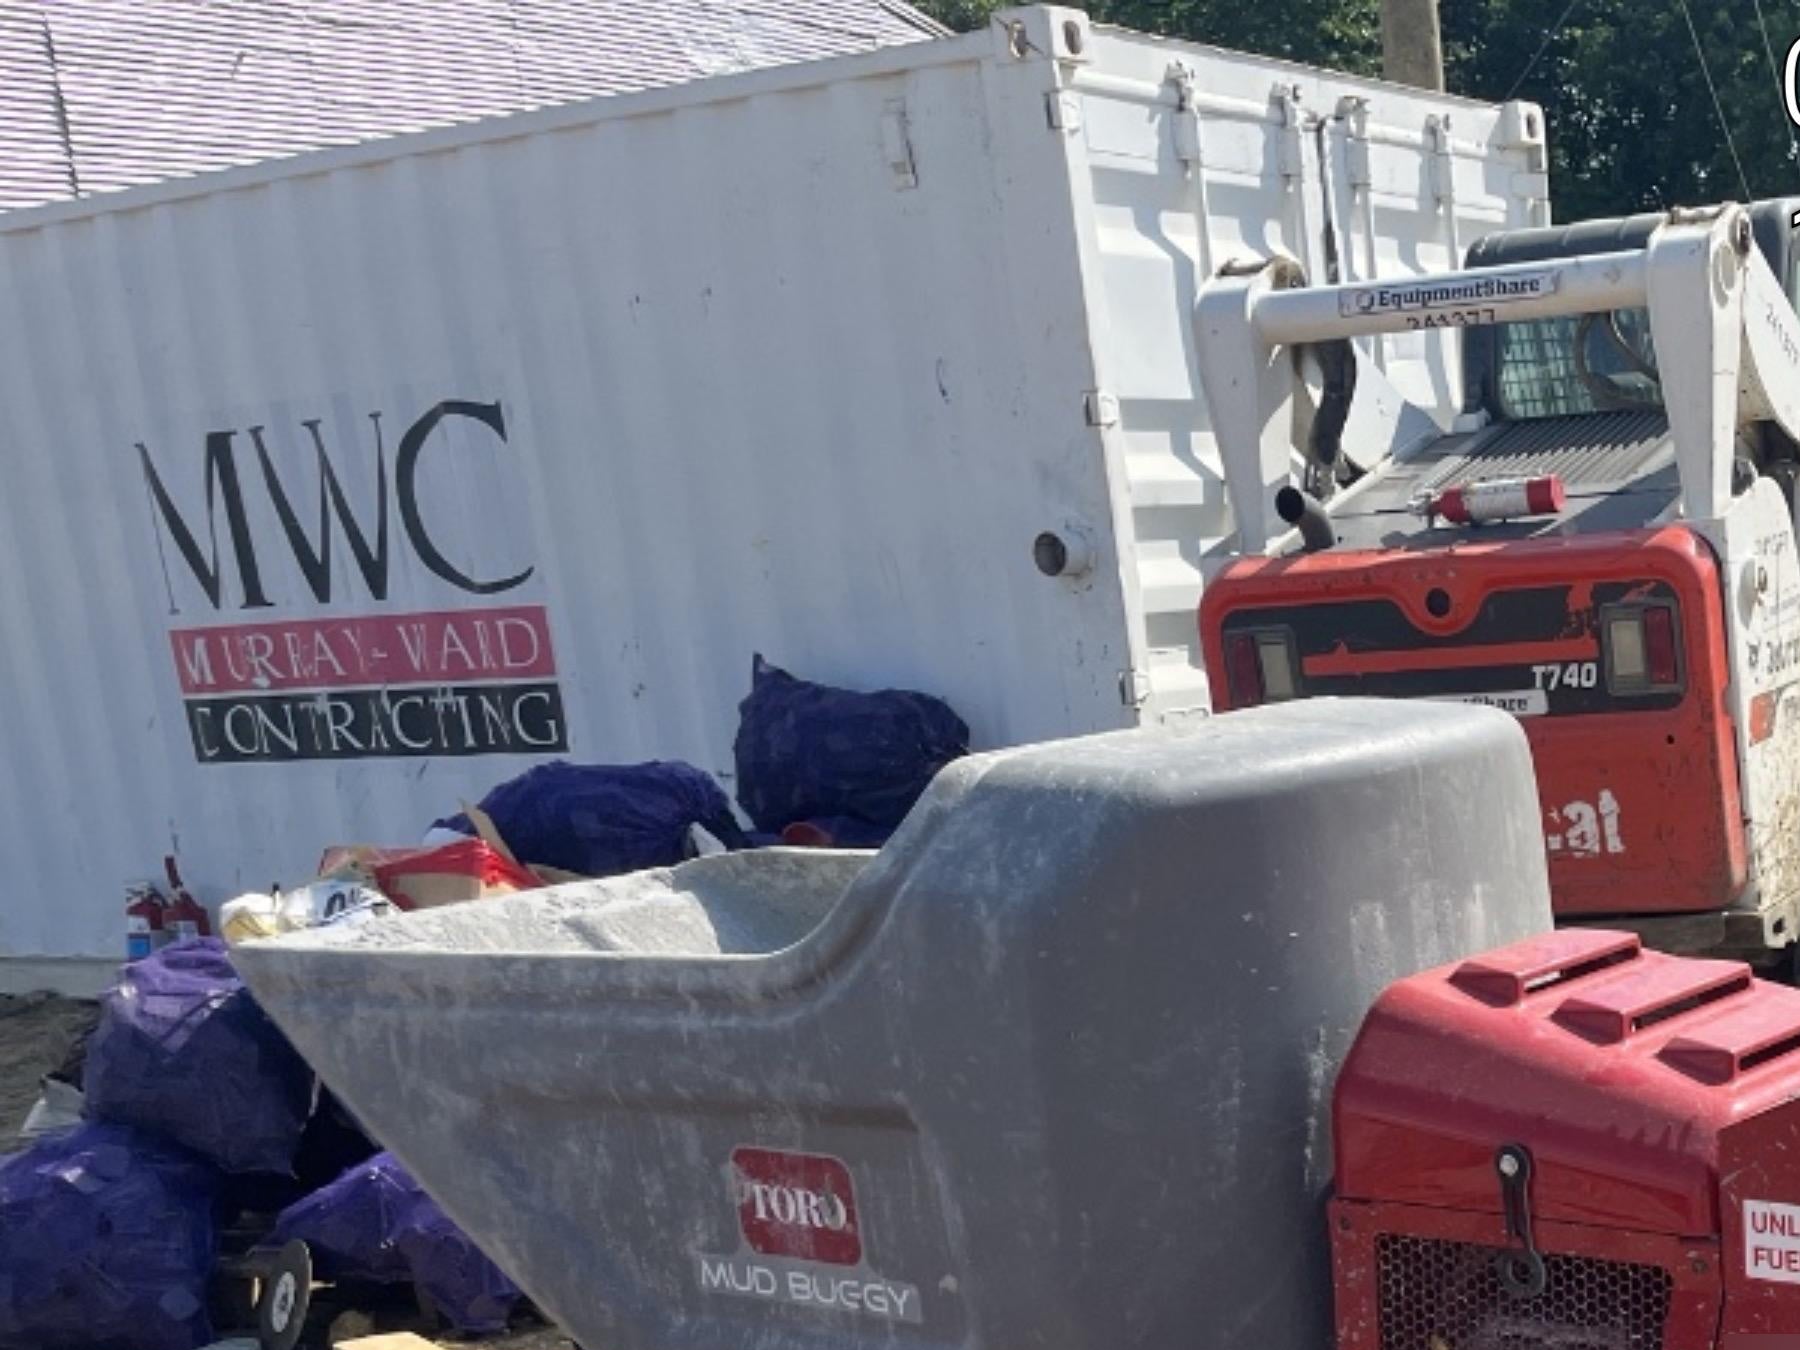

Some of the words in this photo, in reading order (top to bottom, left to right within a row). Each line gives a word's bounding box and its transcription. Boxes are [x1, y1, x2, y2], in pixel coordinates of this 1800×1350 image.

[1378, 278, 1541, 310] EquipmentShare
[134, 400, 534, 614] MWC
[1532, 662, 1597, 690] T740
[197, 691, 560, 758] CONTRACTING
[752, 1184, 847, 1231] TORO
[701, 1259, 778, 1296] MUD
[787, 1271, 909, 1317] BUGGY
